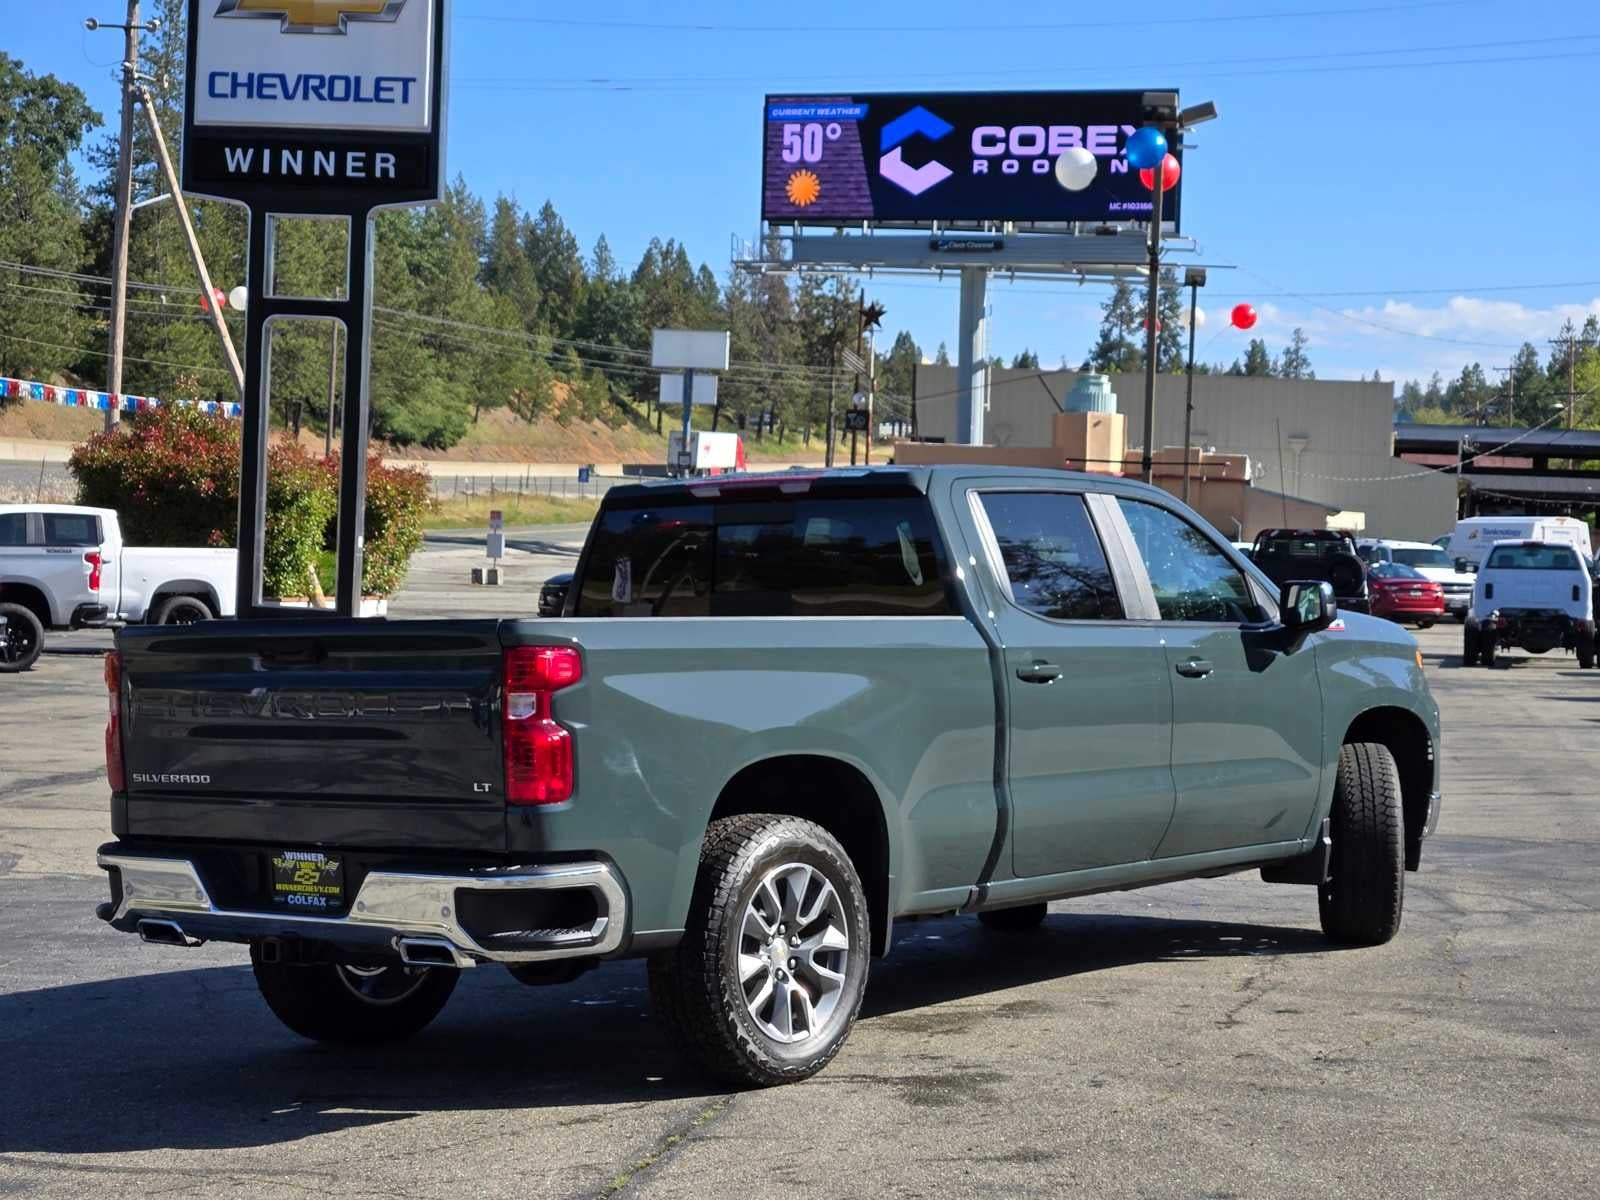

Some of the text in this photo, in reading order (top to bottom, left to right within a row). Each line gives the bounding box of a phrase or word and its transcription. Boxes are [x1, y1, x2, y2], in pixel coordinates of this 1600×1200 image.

[208, 71, 417, 104] CHEVROLET
[772, 107, 861, 117] CURRENT WEATHER
[224, 147, 396, 179] WINNER
[132, 772, 211, 785] SILVERADO
[473, 781, 492, 793] LT
[283, 851, 324, 861] WINNER
[287, 894, 326, 906] COLFAX
